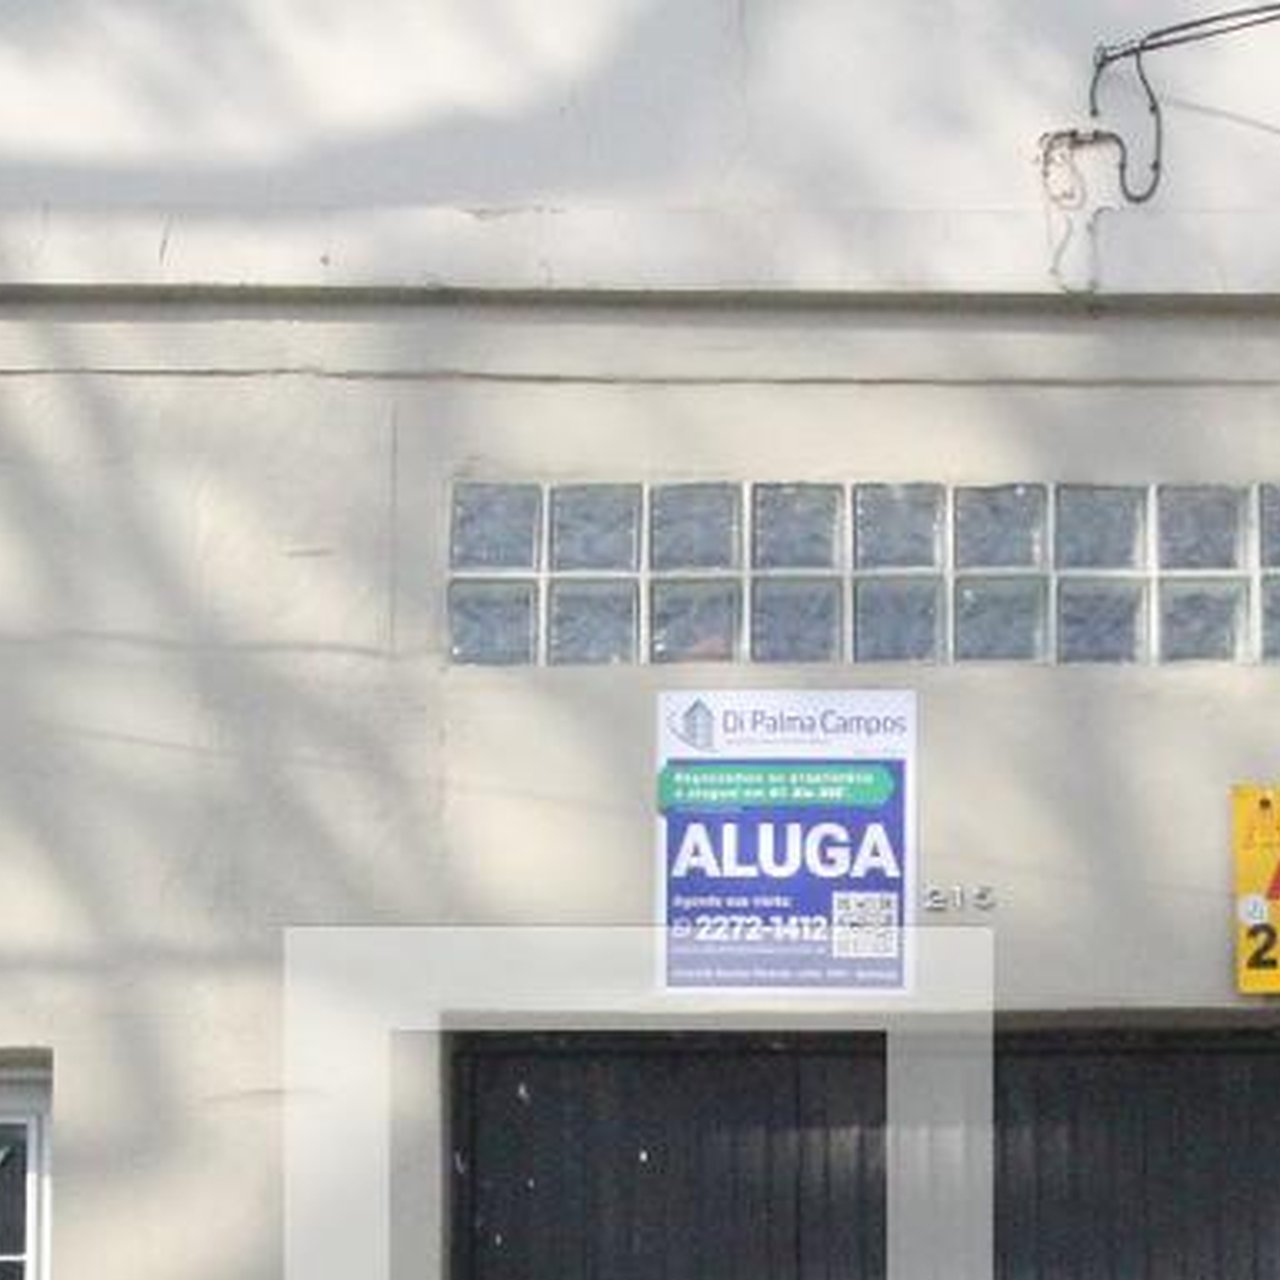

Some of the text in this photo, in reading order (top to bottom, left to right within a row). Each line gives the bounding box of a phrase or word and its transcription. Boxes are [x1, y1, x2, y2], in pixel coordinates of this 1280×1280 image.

[722, 709, 908, 738] Di Palma Campos
[671, 822, 901, 878] ALUGA
[694, 914, 828, 941] 2272-1412
